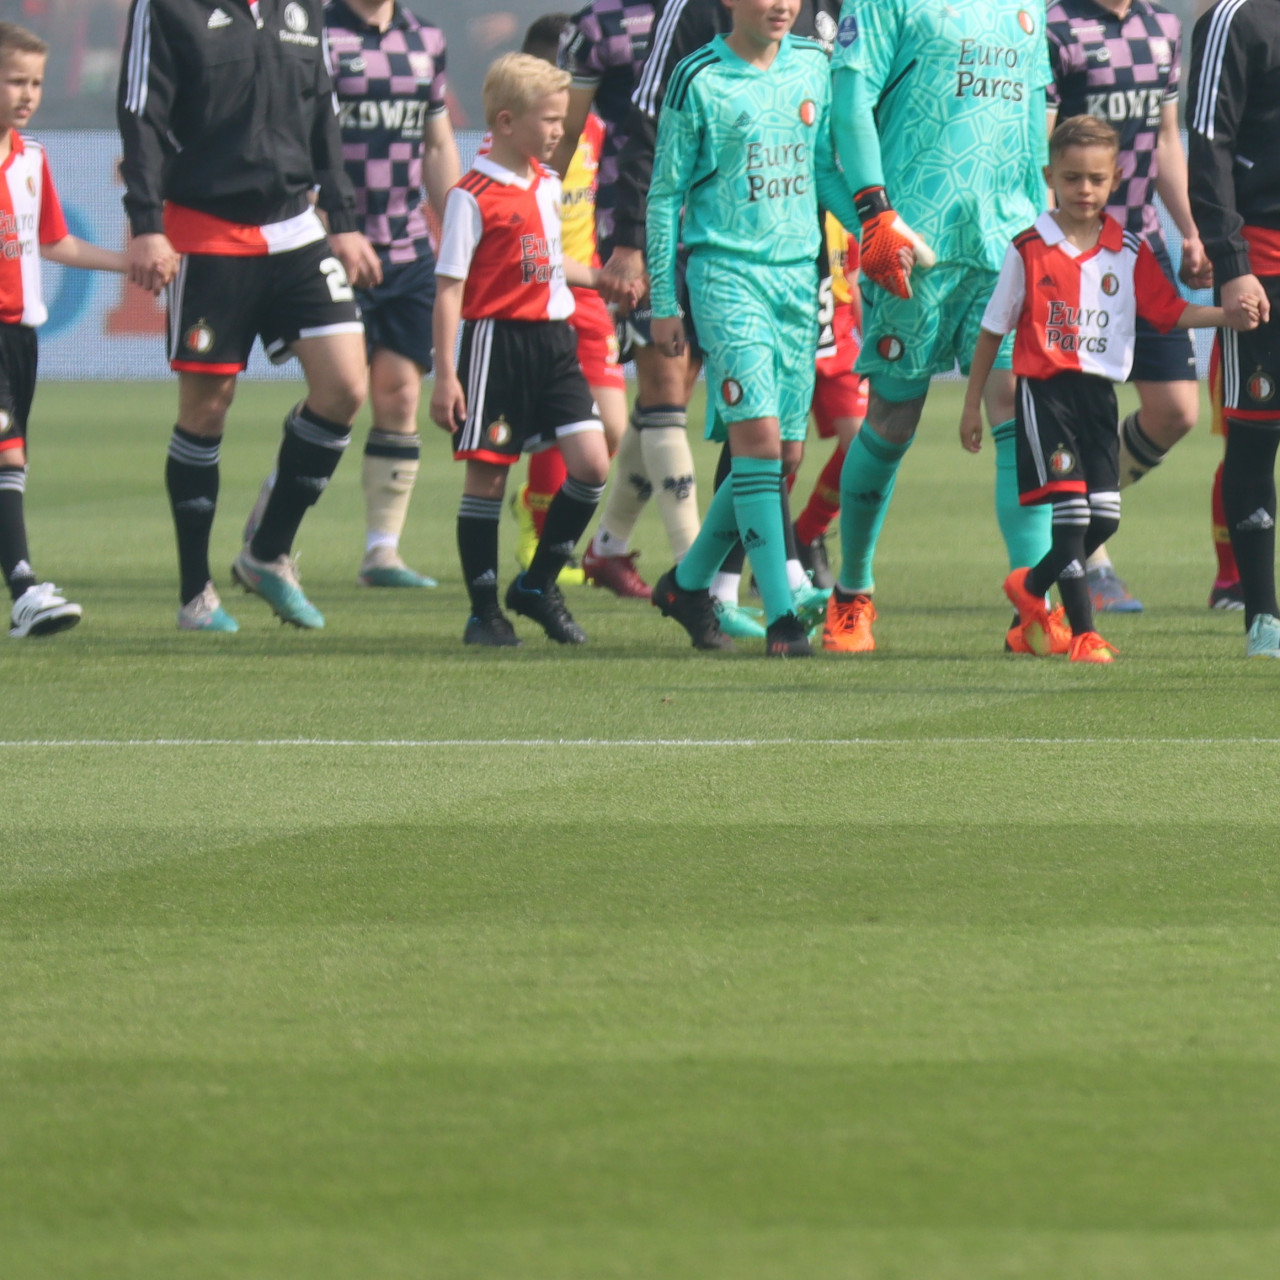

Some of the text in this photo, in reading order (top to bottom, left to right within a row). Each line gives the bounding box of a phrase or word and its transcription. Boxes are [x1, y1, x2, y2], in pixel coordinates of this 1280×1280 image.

[957, 37, 1019, 69] Euro
[953, 70, 1025, 103] Parcs
[1086, 88, 1164, 121] KOWE
[746, 173, 810, 203] Parc
[520, 233, 563, 261] Eur
[319, 256, 354, 303] 2
[520, 261, 565, 284] Parc
[1046, 300, 1110, 329] Euro
[1045, 327, 1109, 353] Parcs
